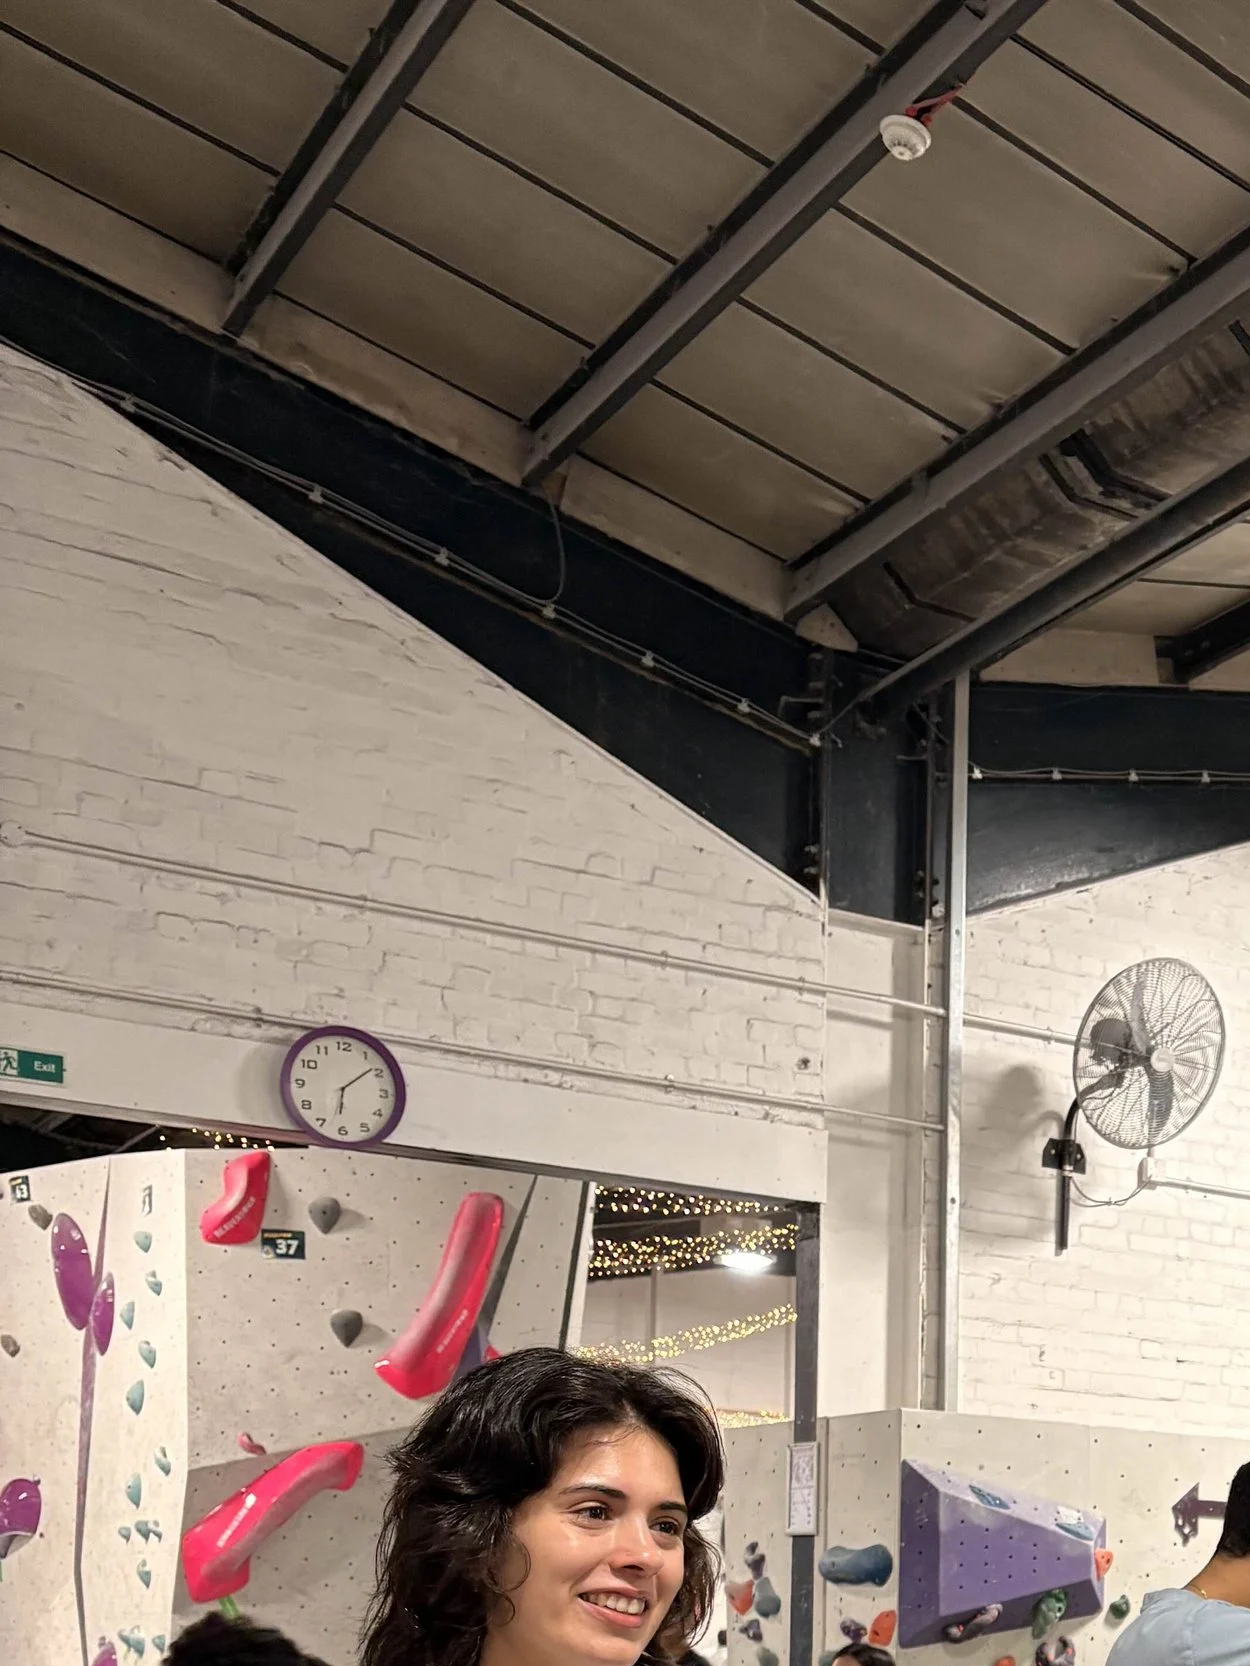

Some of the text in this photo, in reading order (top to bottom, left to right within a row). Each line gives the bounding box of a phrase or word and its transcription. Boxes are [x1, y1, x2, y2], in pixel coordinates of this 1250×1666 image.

[315, 1045, 328, 1056] 11
[336, 1041, 352, 1052] 12
[363, 1051, 368, 1060] 1
[33, 1060, 56, 1073] Exit
[301, 1059, 318, 1070] 10
[374, 1068, 384, 1078] 2
[295, 1078, 306, 1088] 9
[379, 1089, 389, 1099] 3
[301, 1099, 312, 1110] 8
[372, 1109, 383, 1118] 4
[315, 1118, 327, 1128] 7
[360, 1122, 370, 1133] 5
[338, 1126, 349, 1136] 6
[275, 1239, 299, 1255] 37
